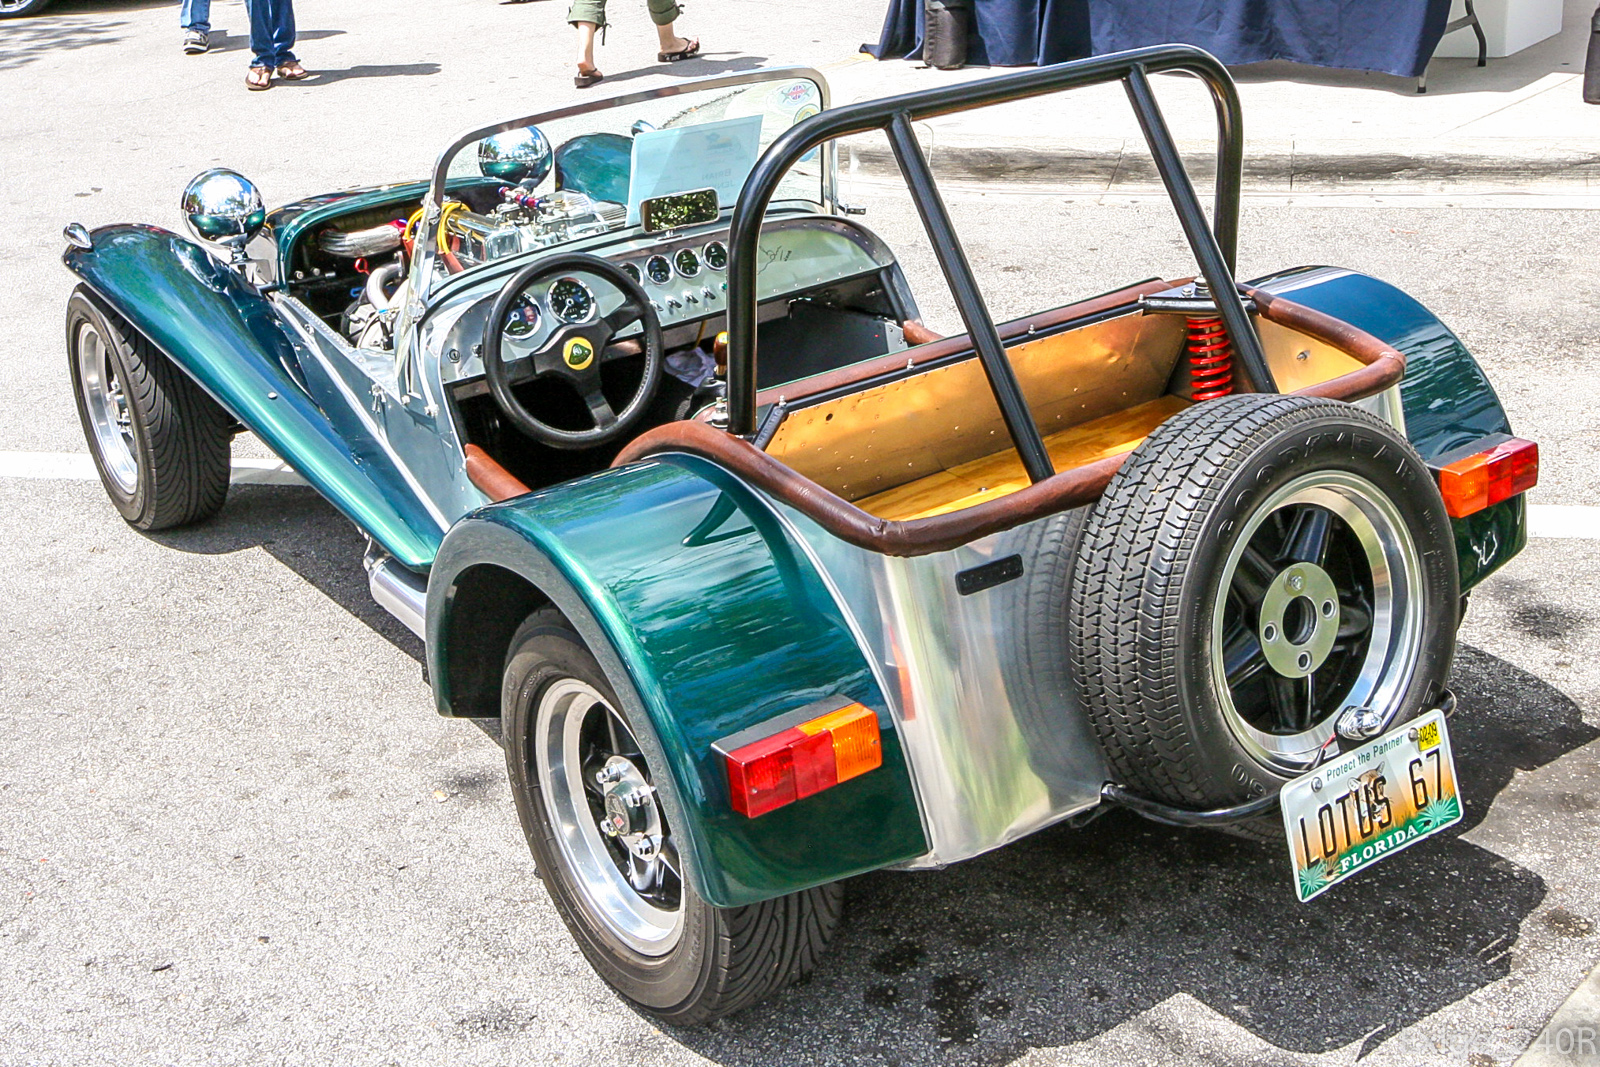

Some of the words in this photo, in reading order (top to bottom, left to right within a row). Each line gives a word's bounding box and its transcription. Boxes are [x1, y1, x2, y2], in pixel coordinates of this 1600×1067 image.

[1216, 431, 1416, 541] GOODYEAR
[1326, 759, 1356, 782] Protect
[1358, 751, 1371, 766] the
[1372, 735, 1404, 761] Panther
[1298, 775, 1393, 869] LOTUS
[1408, 748, 1443, 811] 67
[1340, 826, 1419, 873] FLORIDA
